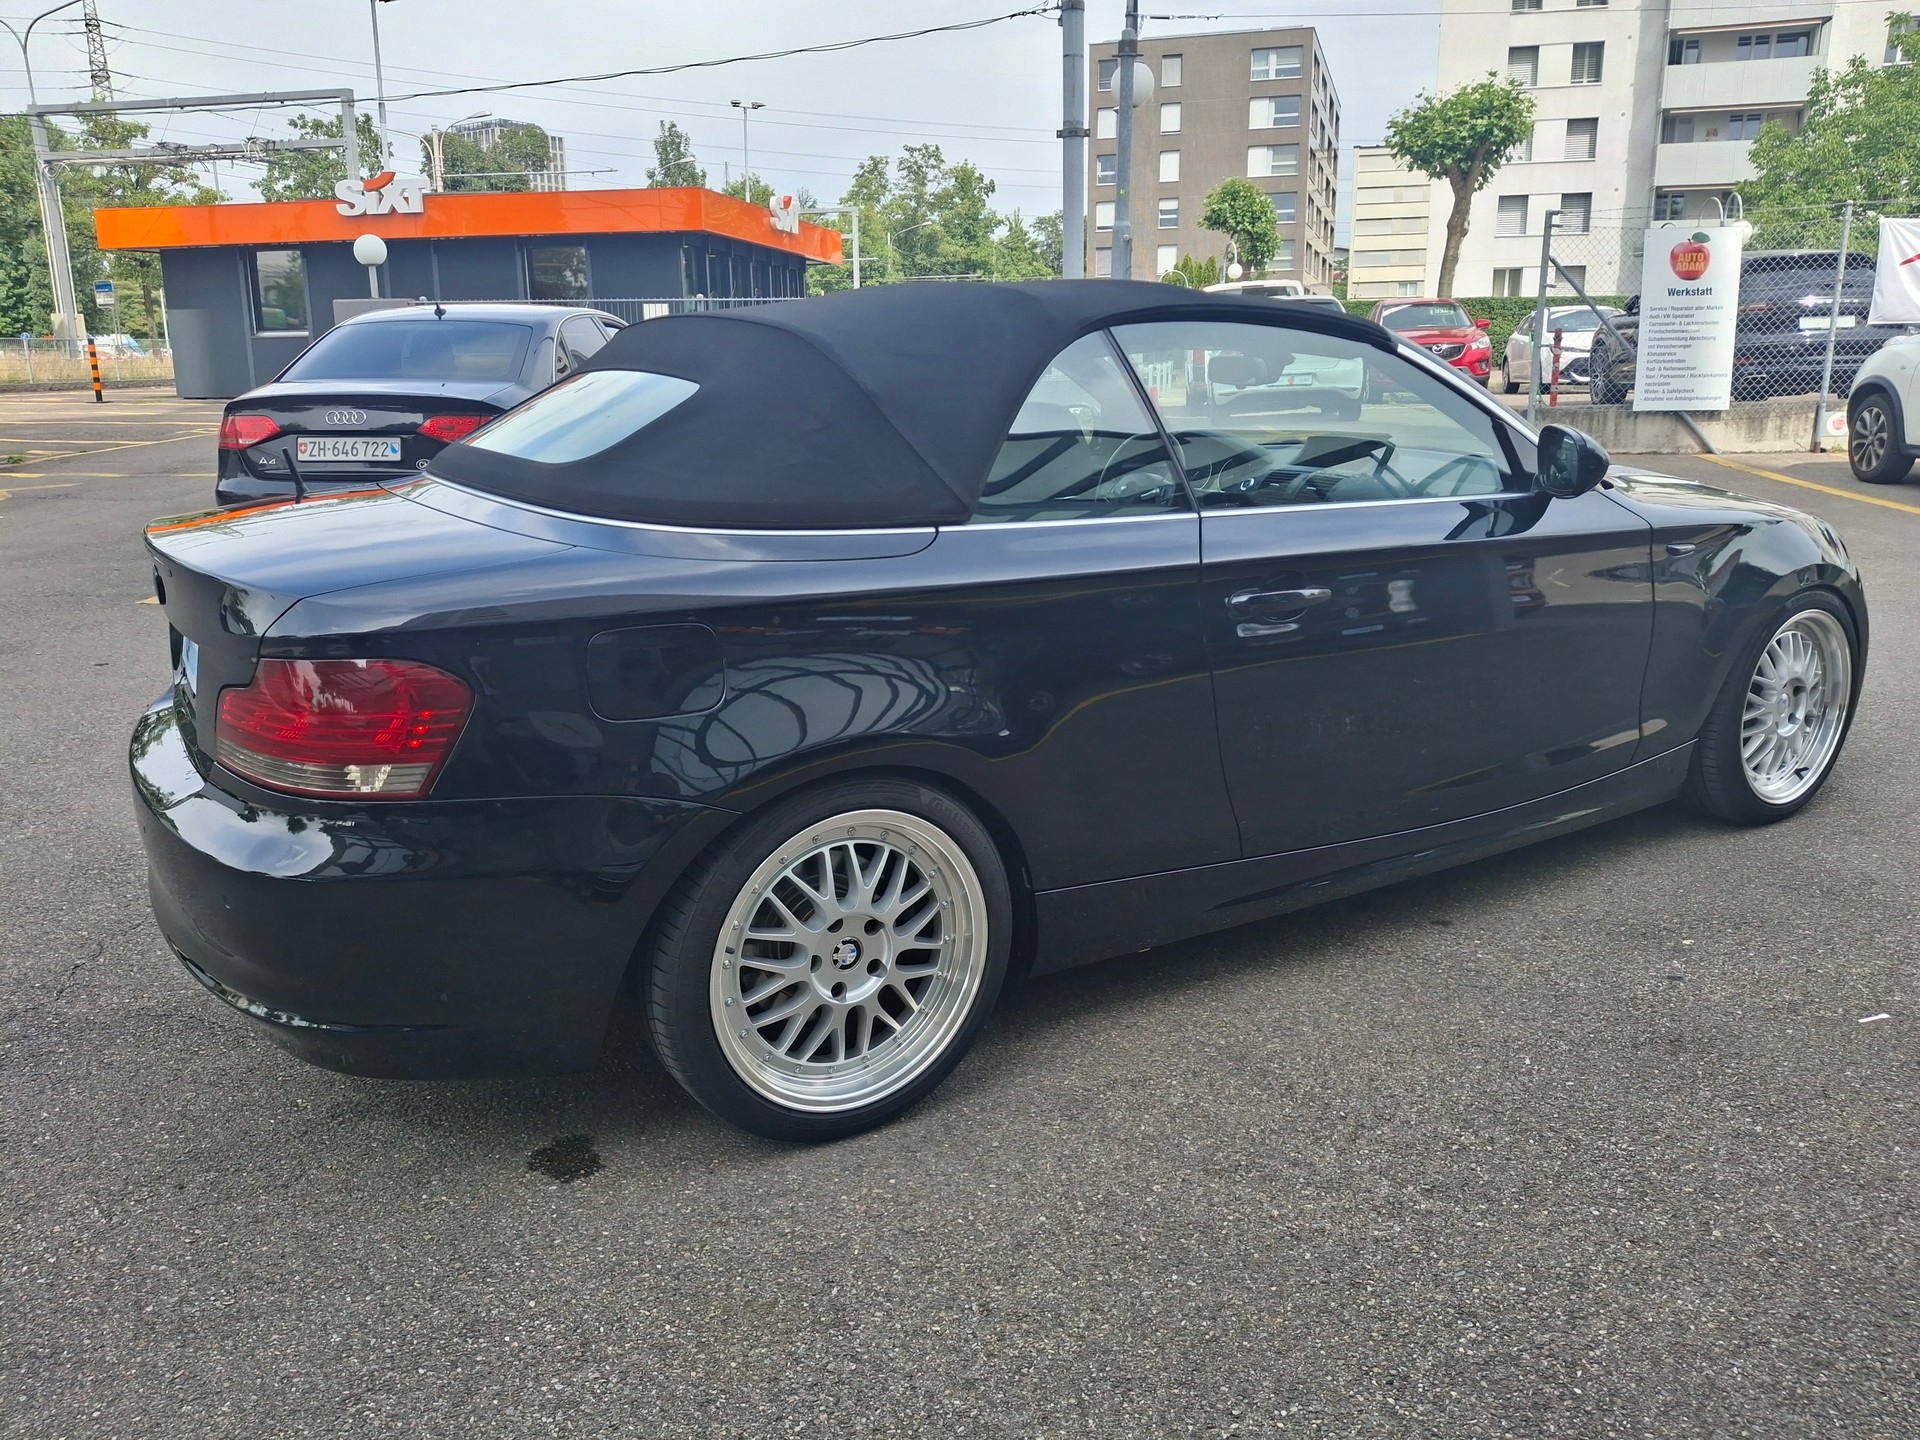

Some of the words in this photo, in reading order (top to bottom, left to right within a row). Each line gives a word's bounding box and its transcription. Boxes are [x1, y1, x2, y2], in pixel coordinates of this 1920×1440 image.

[1678, 252, 1705, 262] AUTO
[1676, 261, 1705, 272] ADAM
[1667, 287, 1713, 296] Werkstatt
[259, 456, 276, 464] A4
